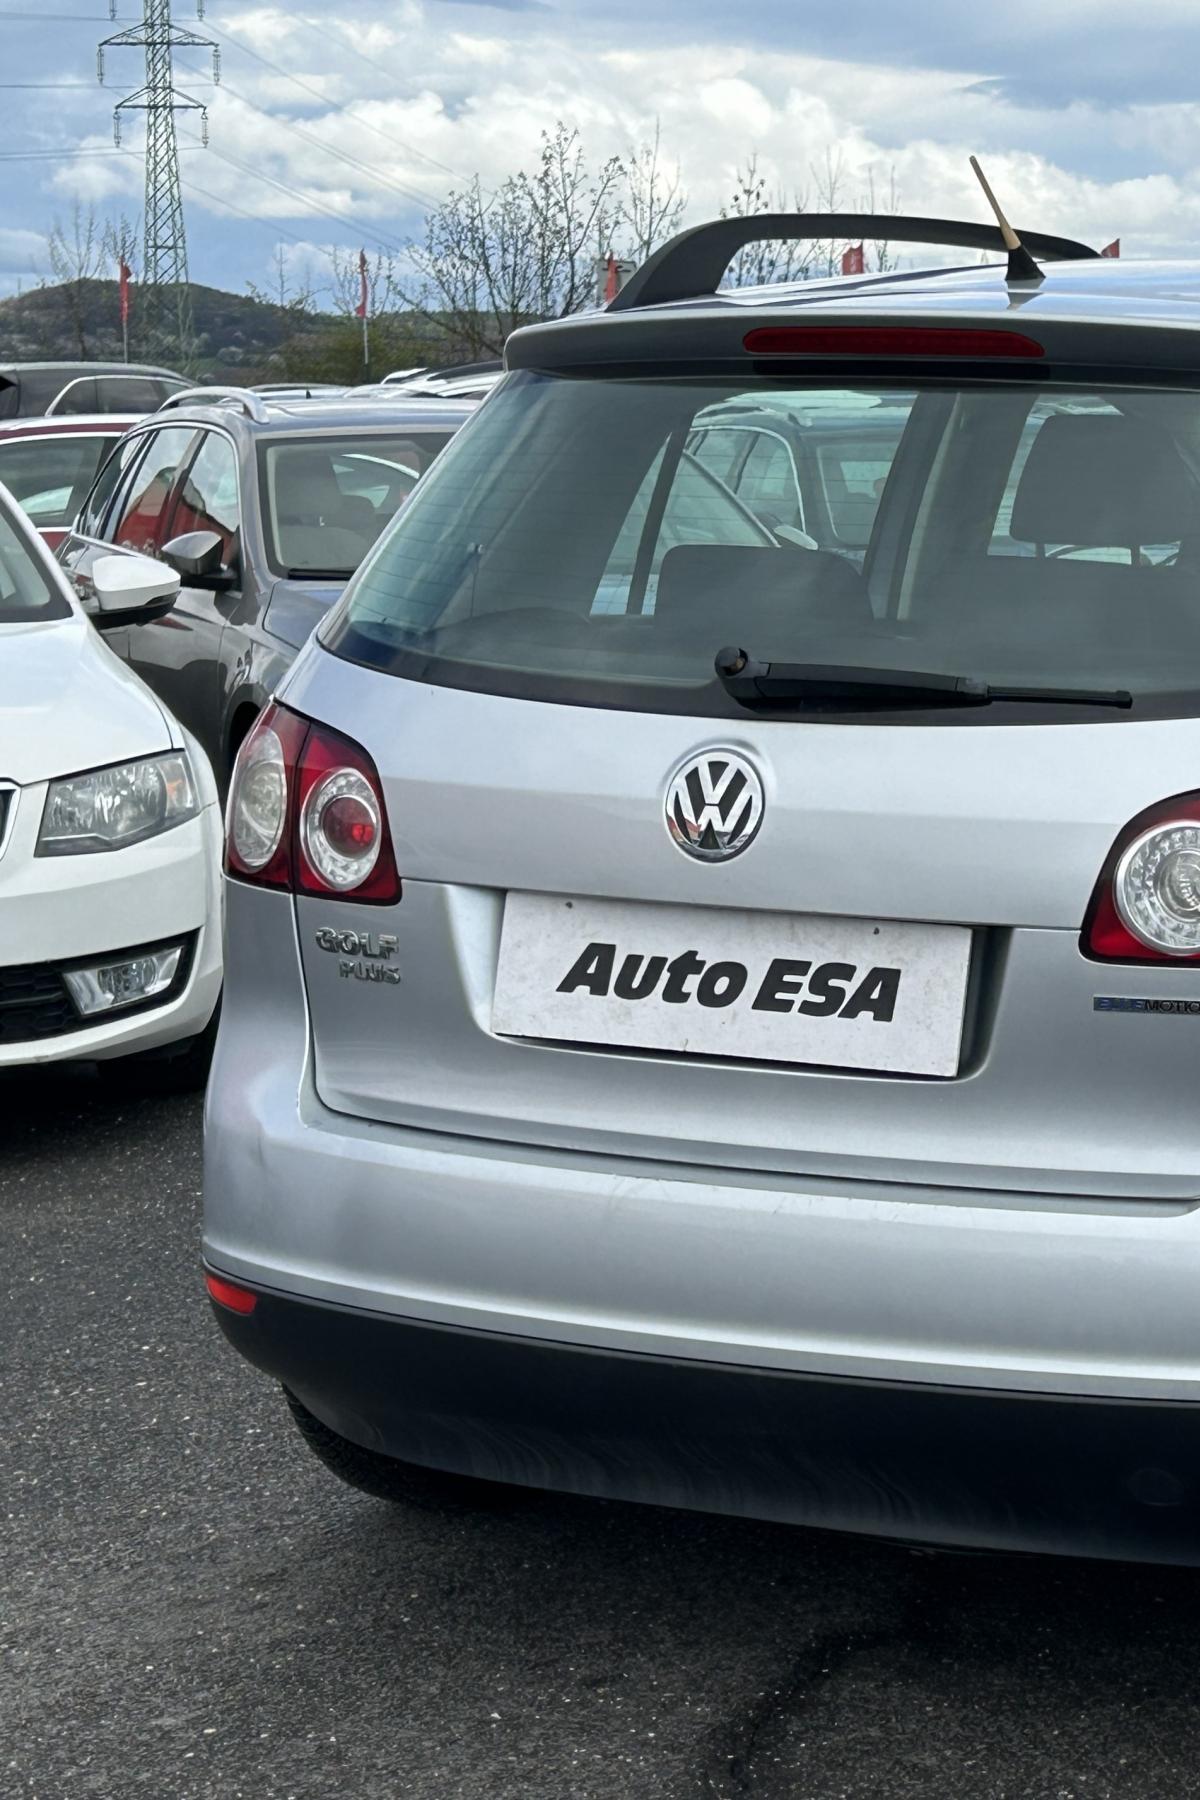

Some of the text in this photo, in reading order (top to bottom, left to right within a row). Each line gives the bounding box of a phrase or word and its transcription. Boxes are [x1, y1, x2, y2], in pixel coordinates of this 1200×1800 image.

[666, 750, 764, 863] VW
[316, 926, 399, 960] GOLF
[339, 959, 401, 984] PLUS
[555, 942, 902, 1023] Auto ESA
